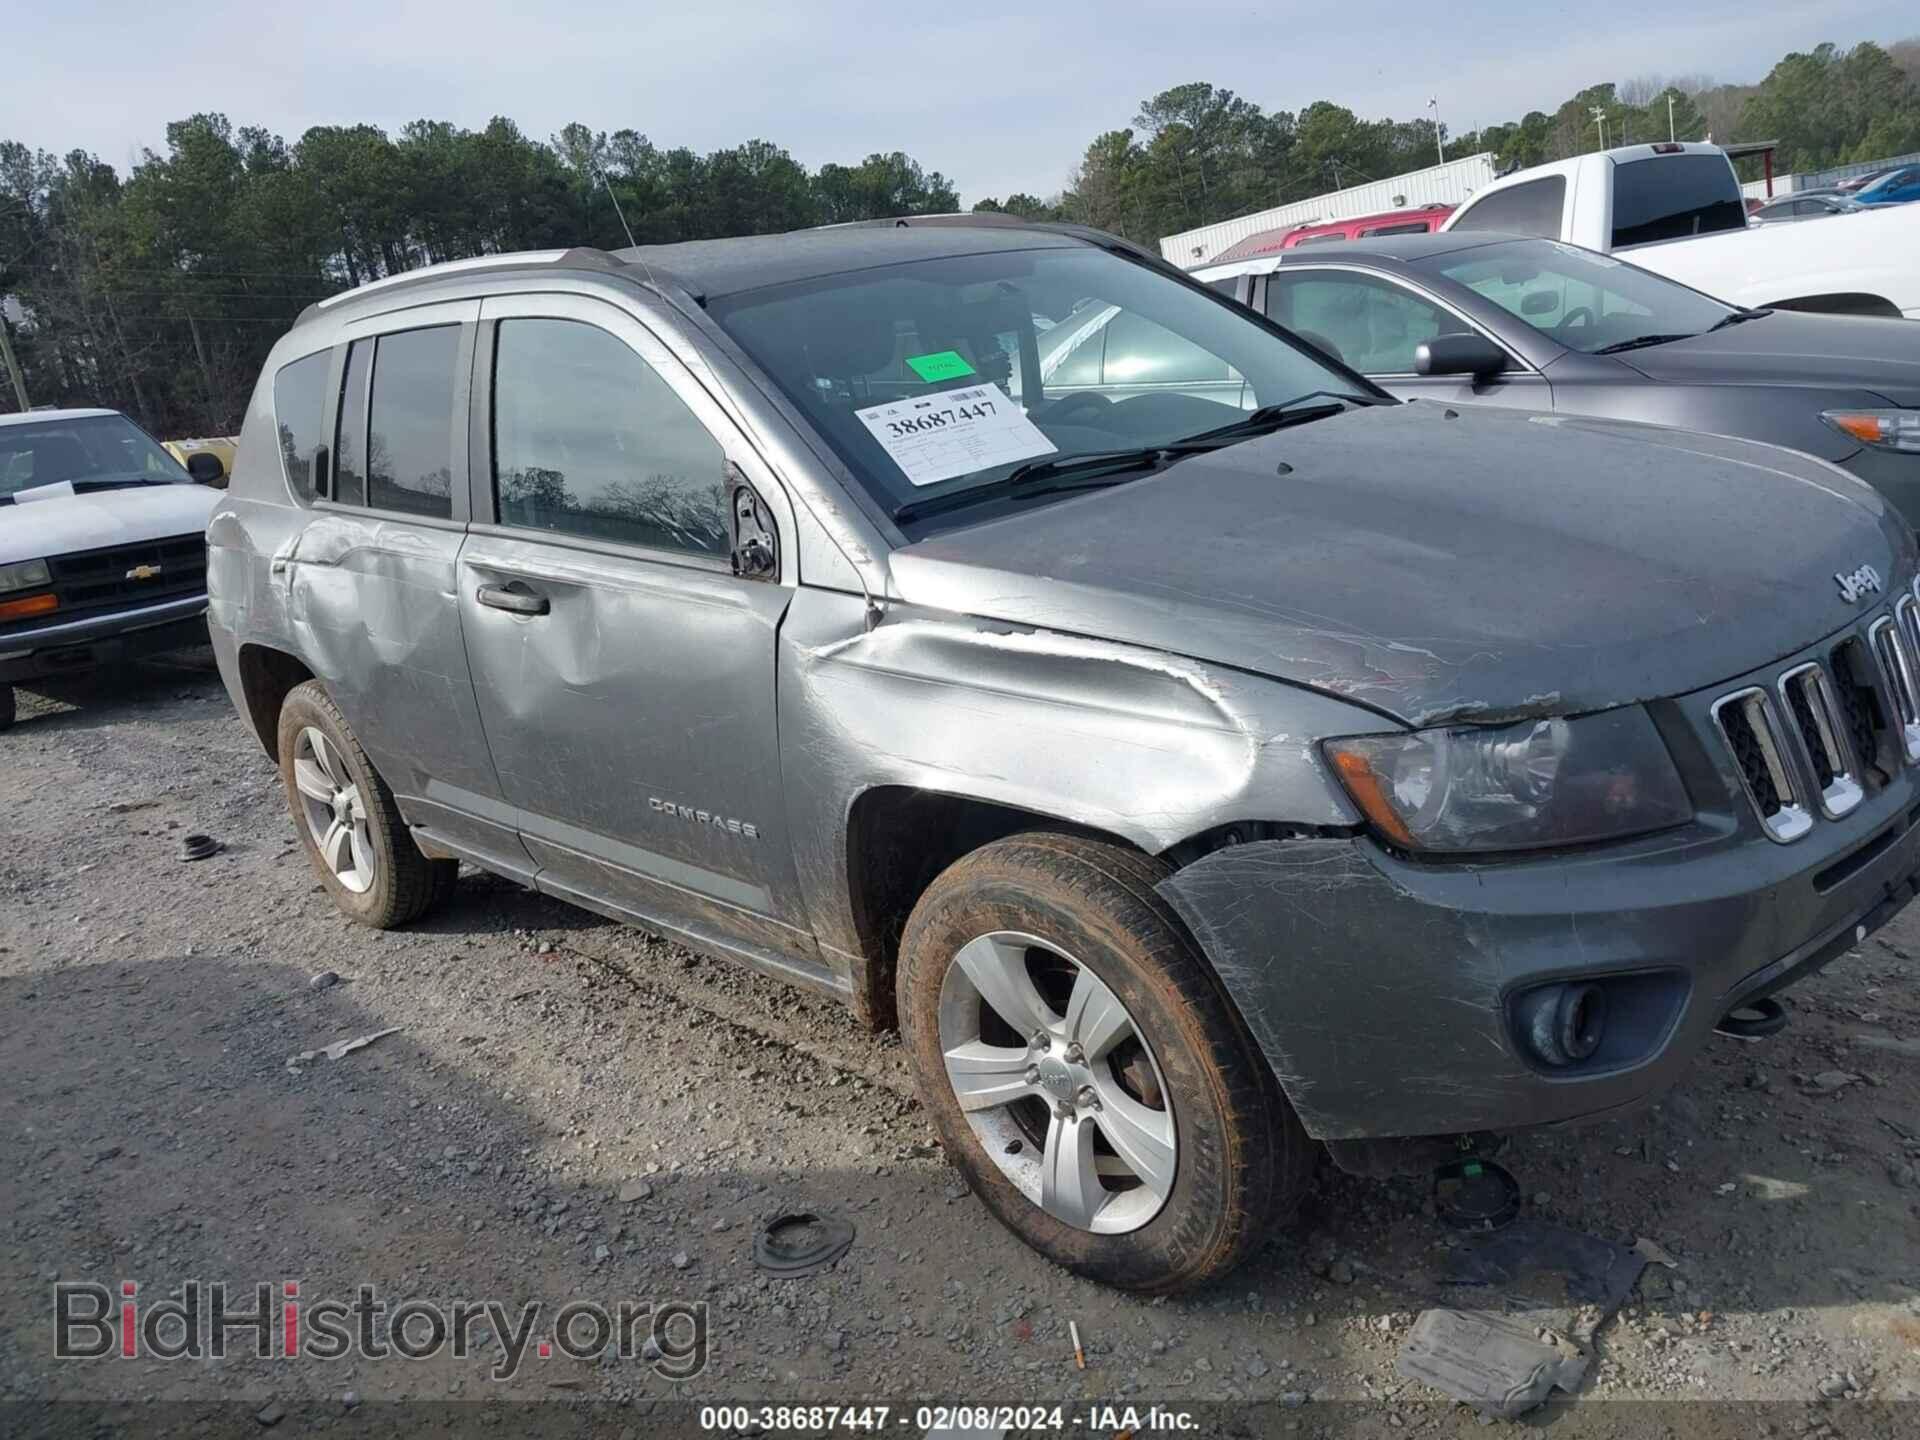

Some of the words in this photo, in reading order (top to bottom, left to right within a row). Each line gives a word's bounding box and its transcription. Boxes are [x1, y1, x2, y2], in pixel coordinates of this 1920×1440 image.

[886, 401, 997, 439] 38687447
[1835, 564, 1881, 602] Jeep
[647, 797, 758, 838] COMPASS
